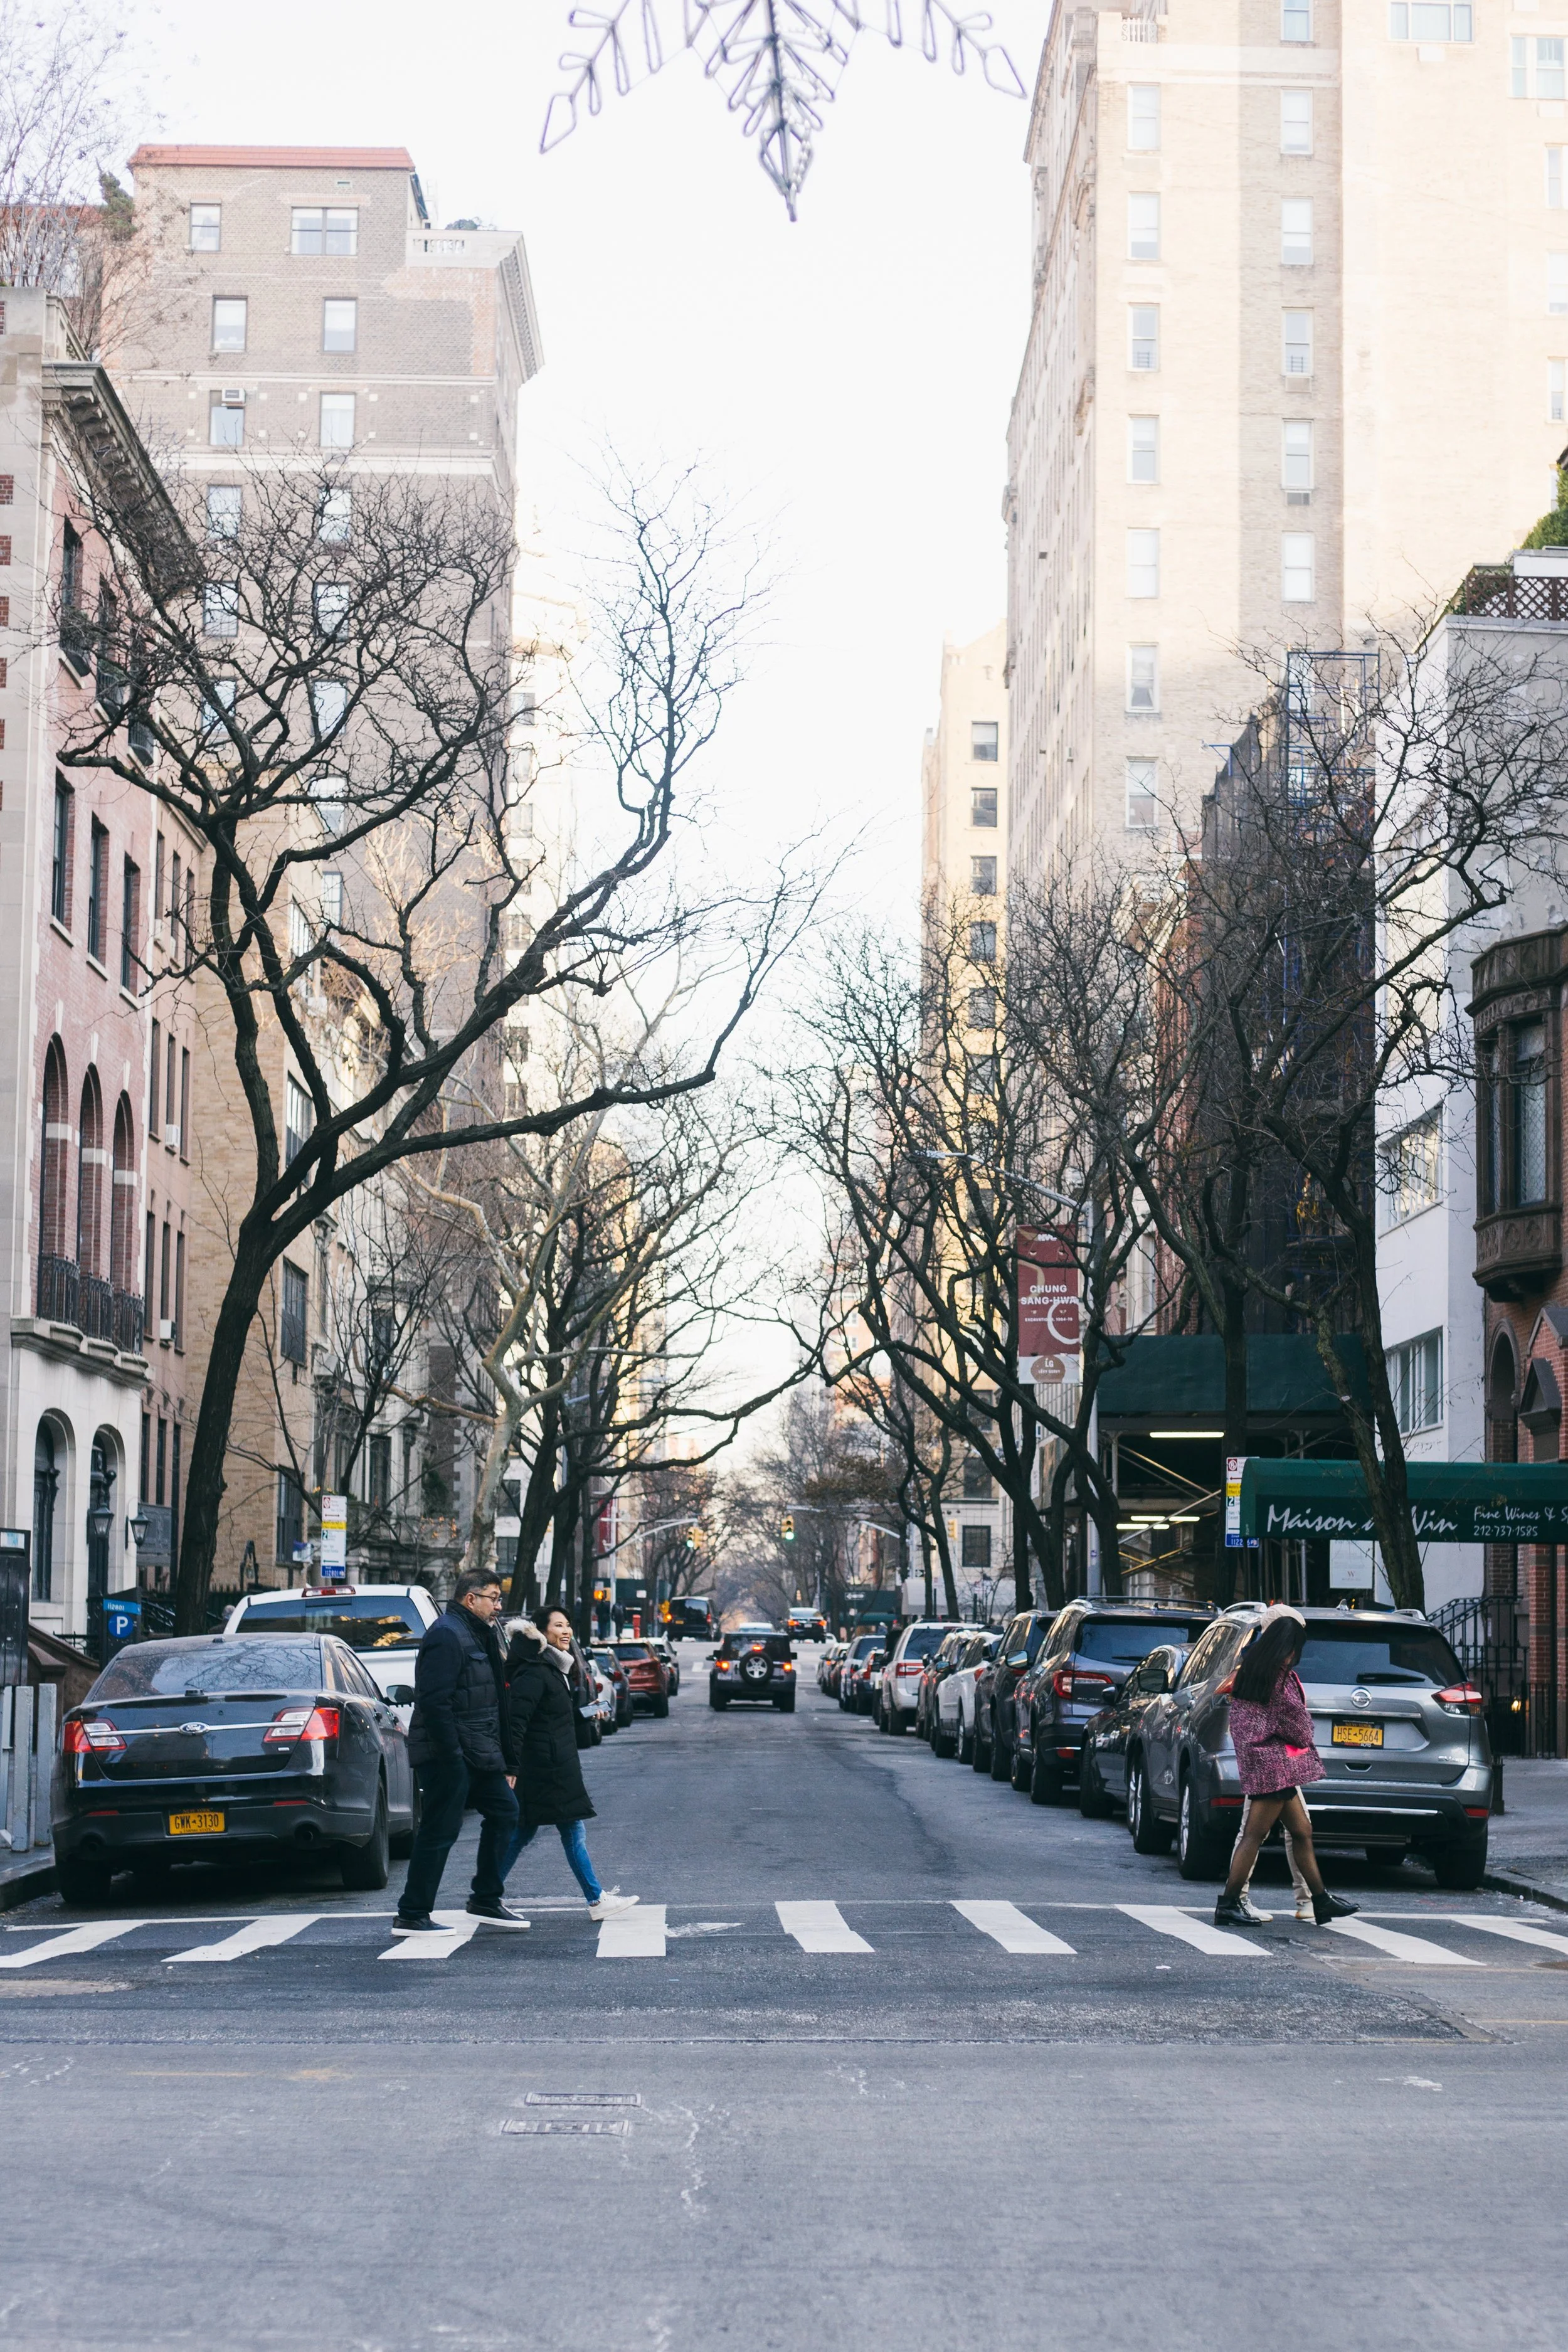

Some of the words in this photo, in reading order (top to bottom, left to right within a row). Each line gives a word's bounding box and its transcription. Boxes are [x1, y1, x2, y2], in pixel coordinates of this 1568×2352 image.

[1029, 1285, 1067, 1293] CHUNG
[1020, 1296, 1077, 1305] SANG-HWA
[1229, 1497, 1234, 1506] 2
[1474, 1505, 1501, 1522] Fine
[1505, 1505, 1540, 1520] Wines
[1544, 1507, 1555, 1521] &
[1267, 1504, 1357, 1532] Maison
[1411, 1506, 1458, 1535] Vin
